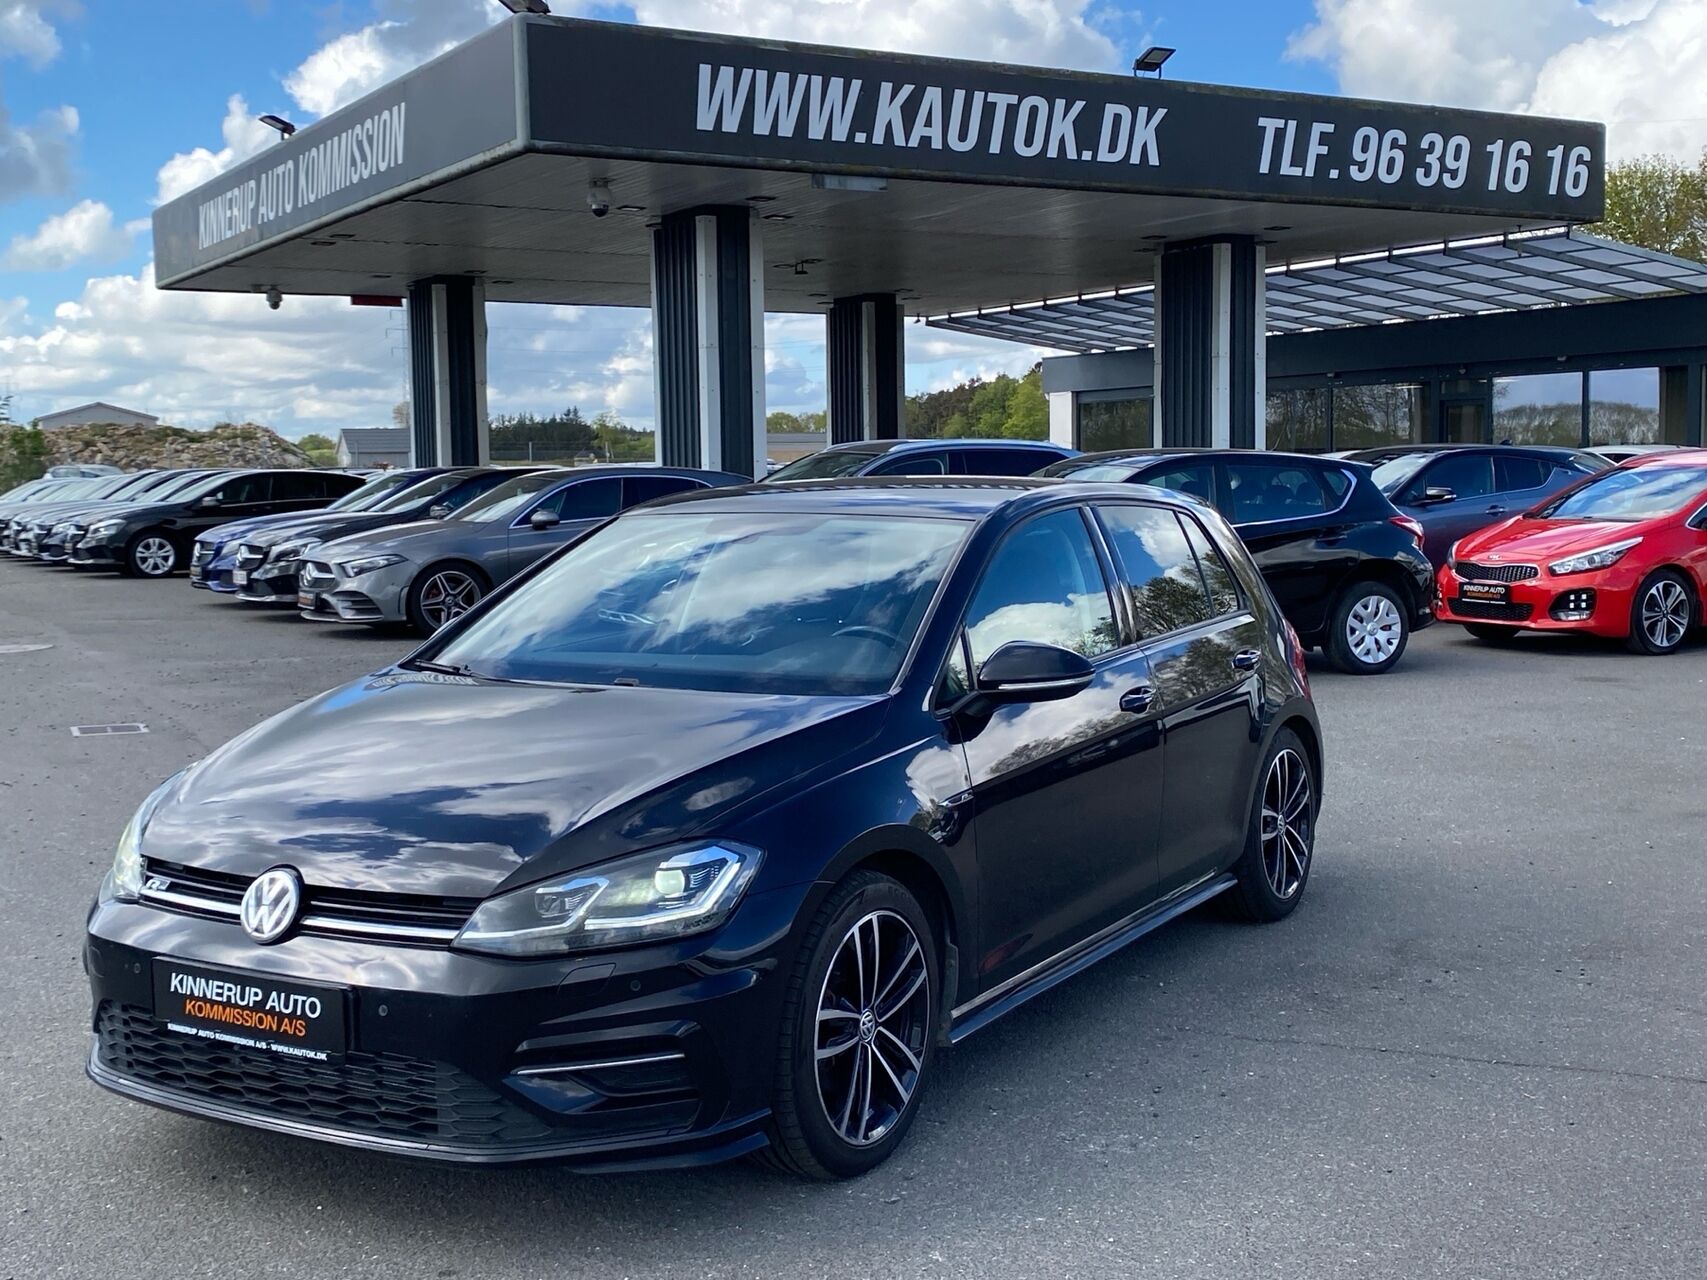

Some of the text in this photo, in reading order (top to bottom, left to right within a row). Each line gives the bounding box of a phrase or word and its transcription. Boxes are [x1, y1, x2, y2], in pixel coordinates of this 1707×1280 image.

[695, 63, 1169, 167] WWW.KAUTOK.DK
[199, 102, 405, 250] KINNERUP AUTO KOMMISSION
[1257, 117, 1591, 198] TLF. 96 39 16 16
[170, 972, 322, 1019] KINNERUP AUTO
[185, 999, 306, 1037] KOMMISSION A/S
